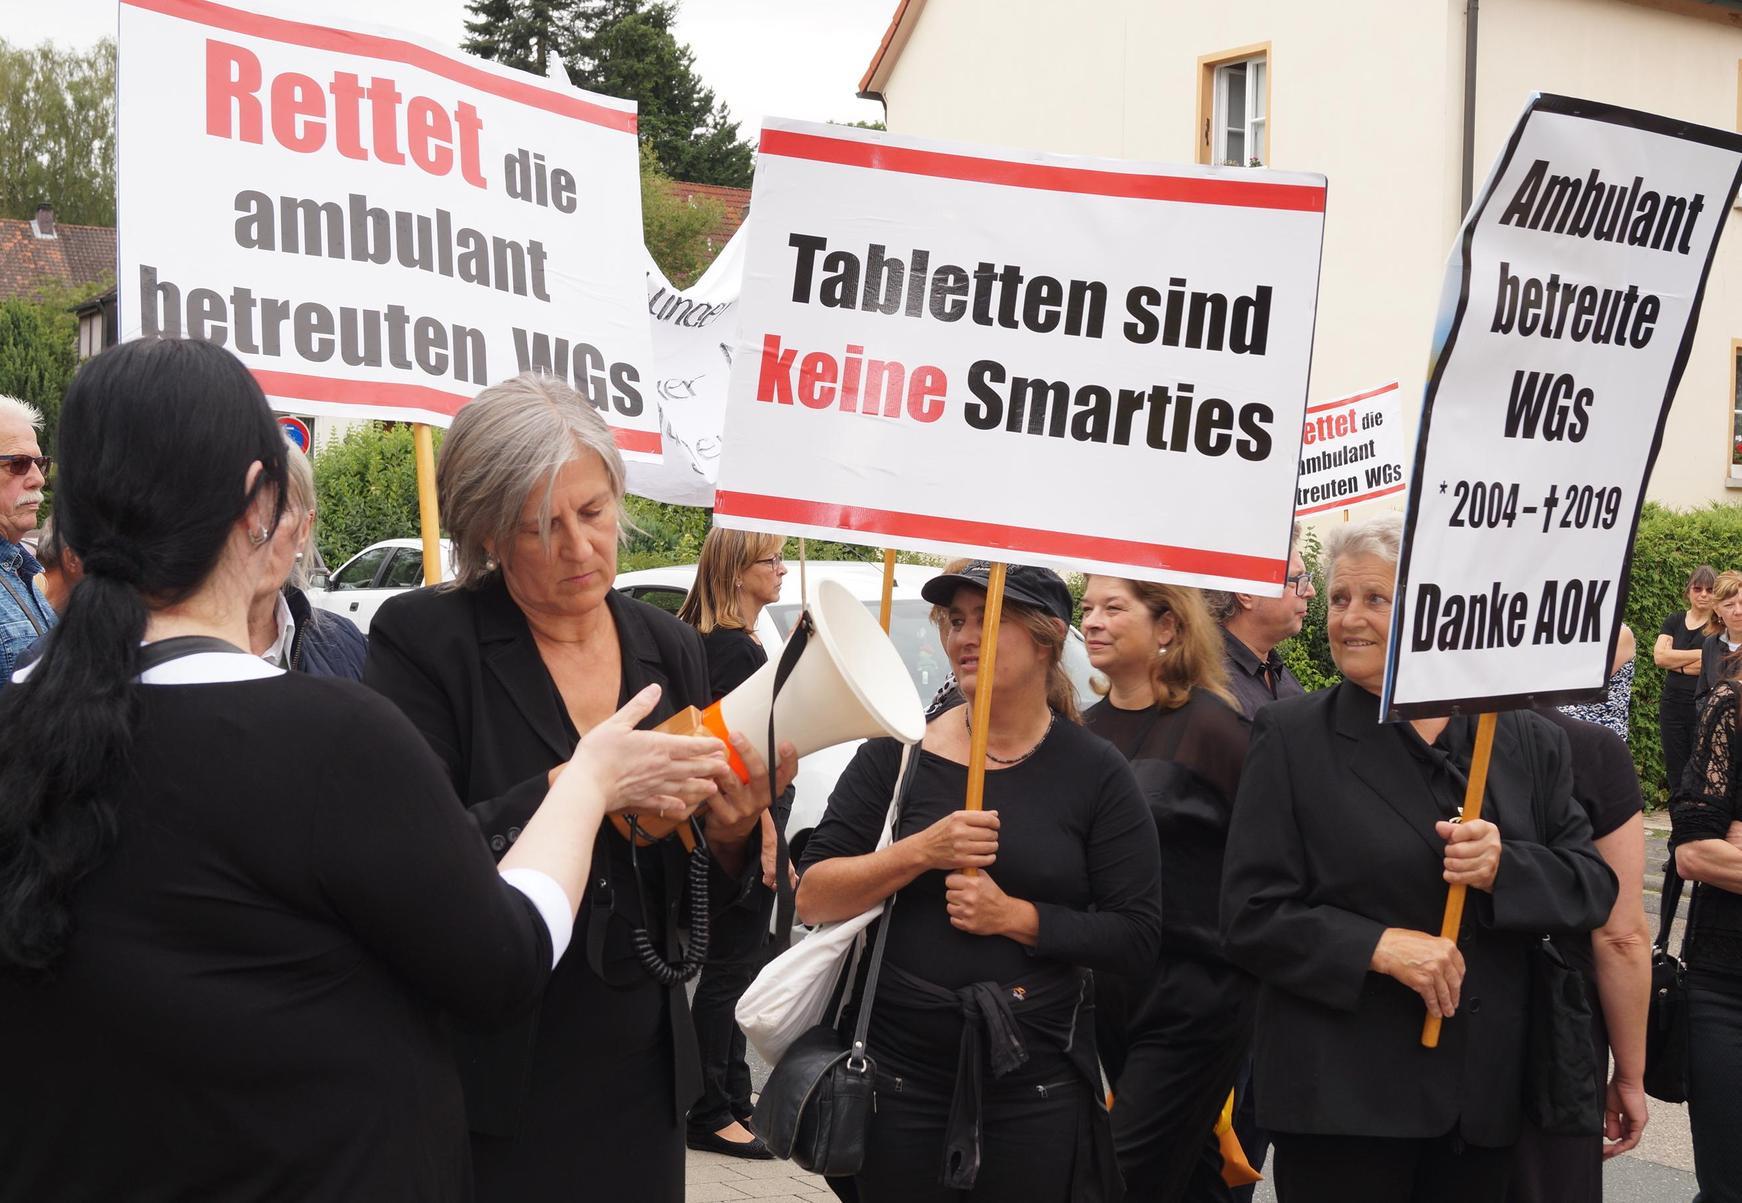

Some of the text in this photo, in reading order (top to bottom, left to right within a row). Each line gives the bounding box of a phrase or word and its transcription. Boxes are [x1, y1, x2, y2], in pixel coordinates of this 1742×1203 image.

[206, 38, 577, 214] Rettet die
[234, 189, 551, 302] ambulant
[1498, 159, 1705, 255] Ambulant
[139, 264, 644, 417] betreuten WGs
[788, 232, 1273, 356] Tabletten sind
[1490, 261, 1661, 349] betreute
[756, 333, 1274, 462] keine Smarties
[1303, 408, 1383, 445] ettet die
[1503, 369, 1595, 443] WGs
[1296, 463, 1402, 506] treuten WGs
[1412, 579, 1611, 652] Danke AOK
